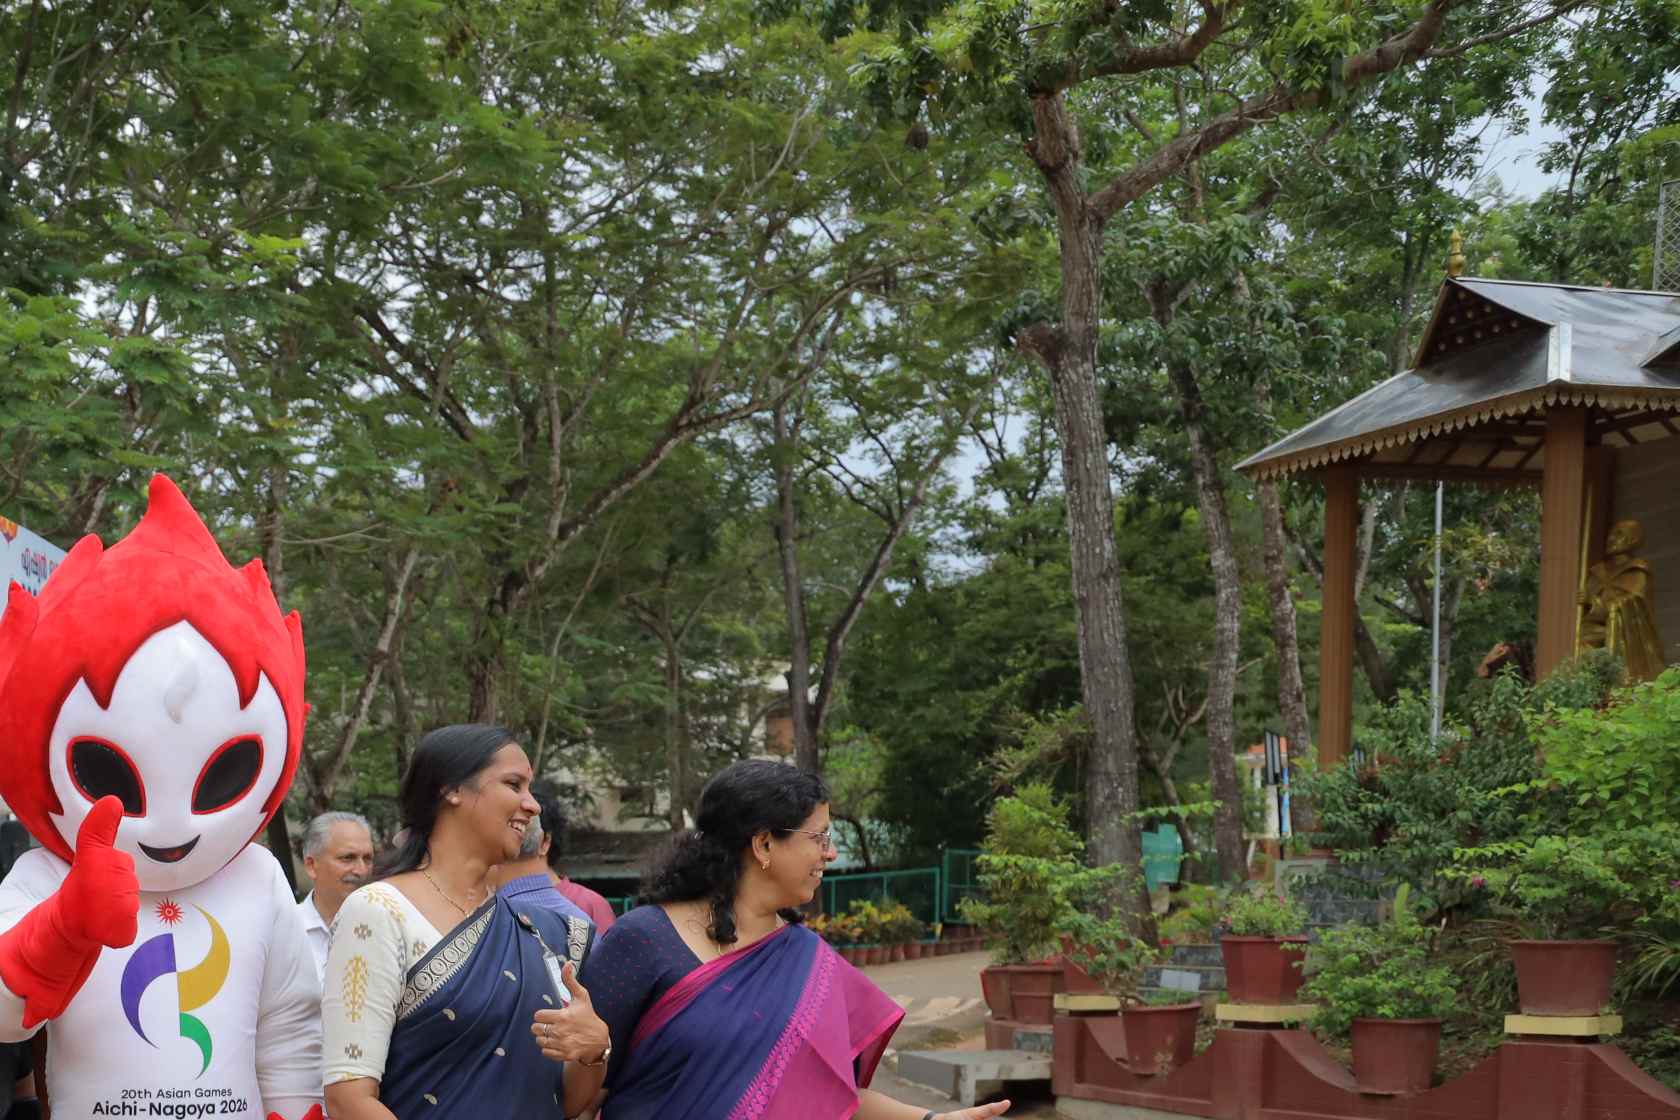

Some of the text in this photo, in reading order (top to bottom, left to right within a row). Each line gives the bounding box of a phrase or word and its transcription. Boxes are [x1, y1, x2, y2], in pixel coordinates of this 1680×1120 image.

[121, 1087, 232, 1099] 20th Asian Games
[93, 1098, 248, 1120] Aichi-Nagoya 2026
